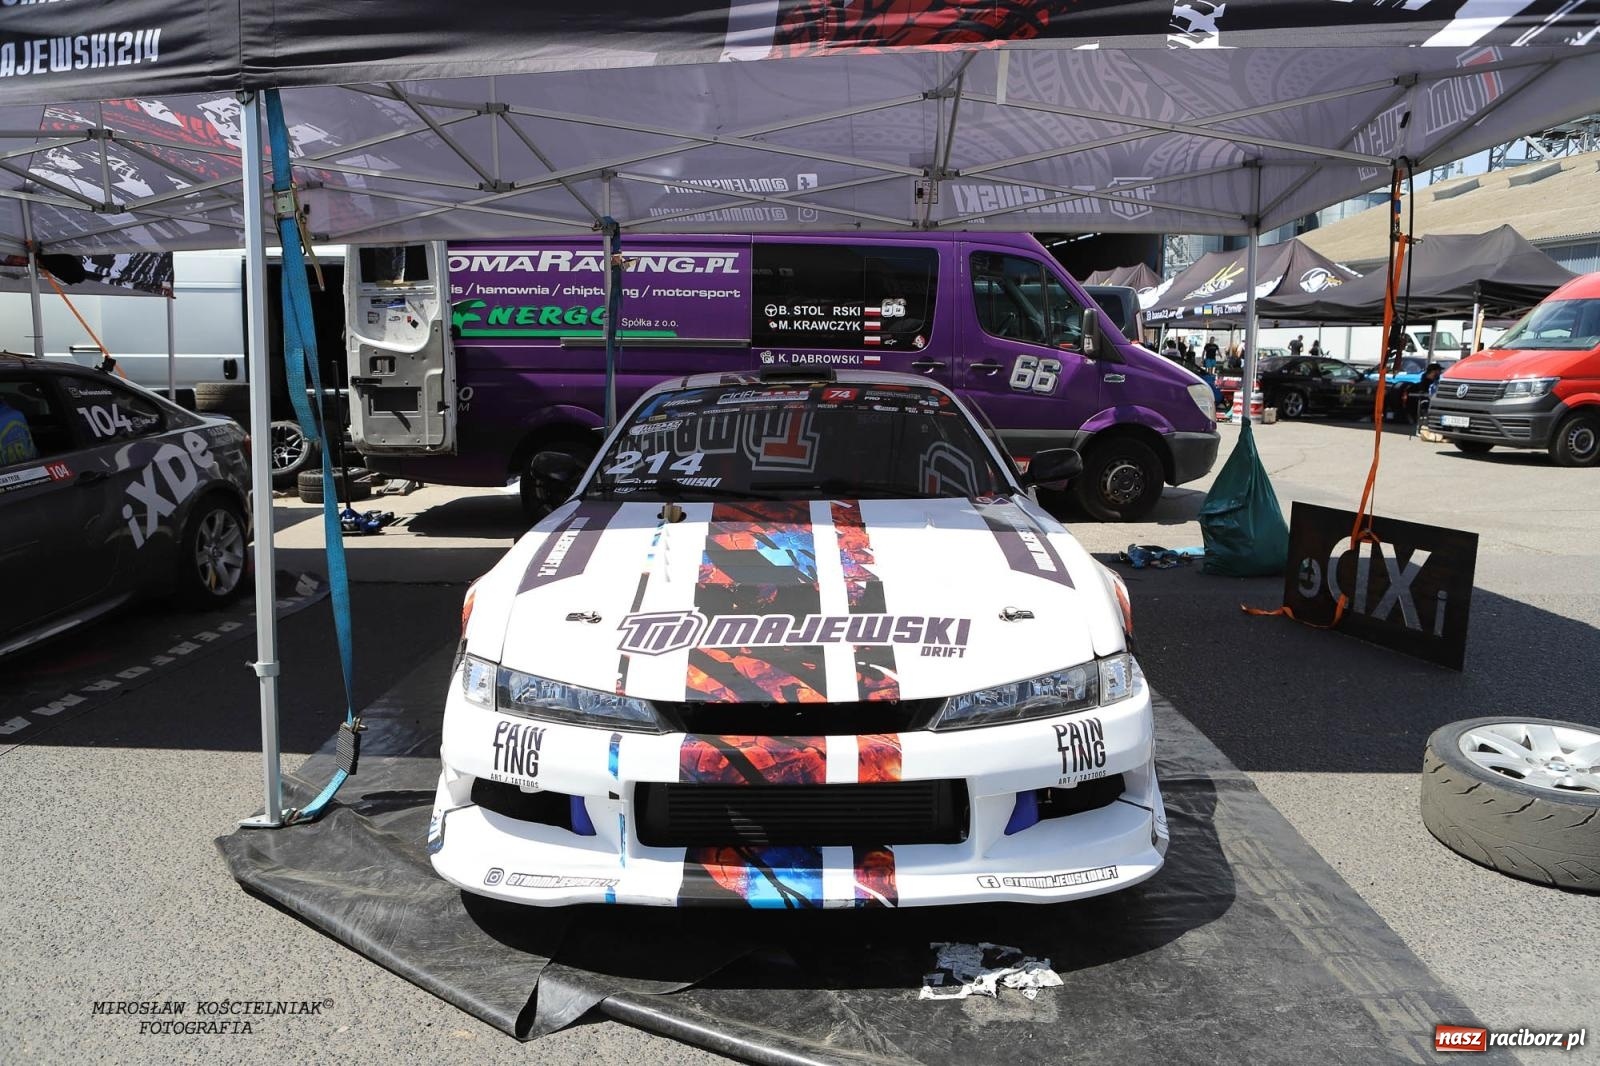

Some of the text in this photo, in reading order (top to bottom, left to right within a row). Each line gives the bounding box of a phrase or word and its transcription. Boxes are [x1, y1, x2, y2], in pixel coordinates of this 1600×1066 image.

[477, 284, 550, 295] hamownia
[652, 287, 741, 299] motorsport
[777, 305, 790, 315] B.
[621, 317, 679, 328] Spółka z o.o.
[778, 321, 861, 331] M. KRAWCZYK
[778, 354, 788, 363] K.
[1009, 354, 1062, 396] 66
[827, 390, 852, 399] 74
[76, 403, 133, 438] 104
[49, 463, 70, 480] 104
[605, 450, 705, 476] 214
[122, 431, 214, 550] iXDe
[703, 615, 972, 646] MAJEWSKI
[920, 646, 967, 658] DRIFT
[494, 720, 547, 752] PAIN
[1052, 717, 1104, 749] PAIN
[493, 741, 540, 778] TING
[1057, 740, 1107, 775] TING
[1058, 776, 1071, 785] ART
